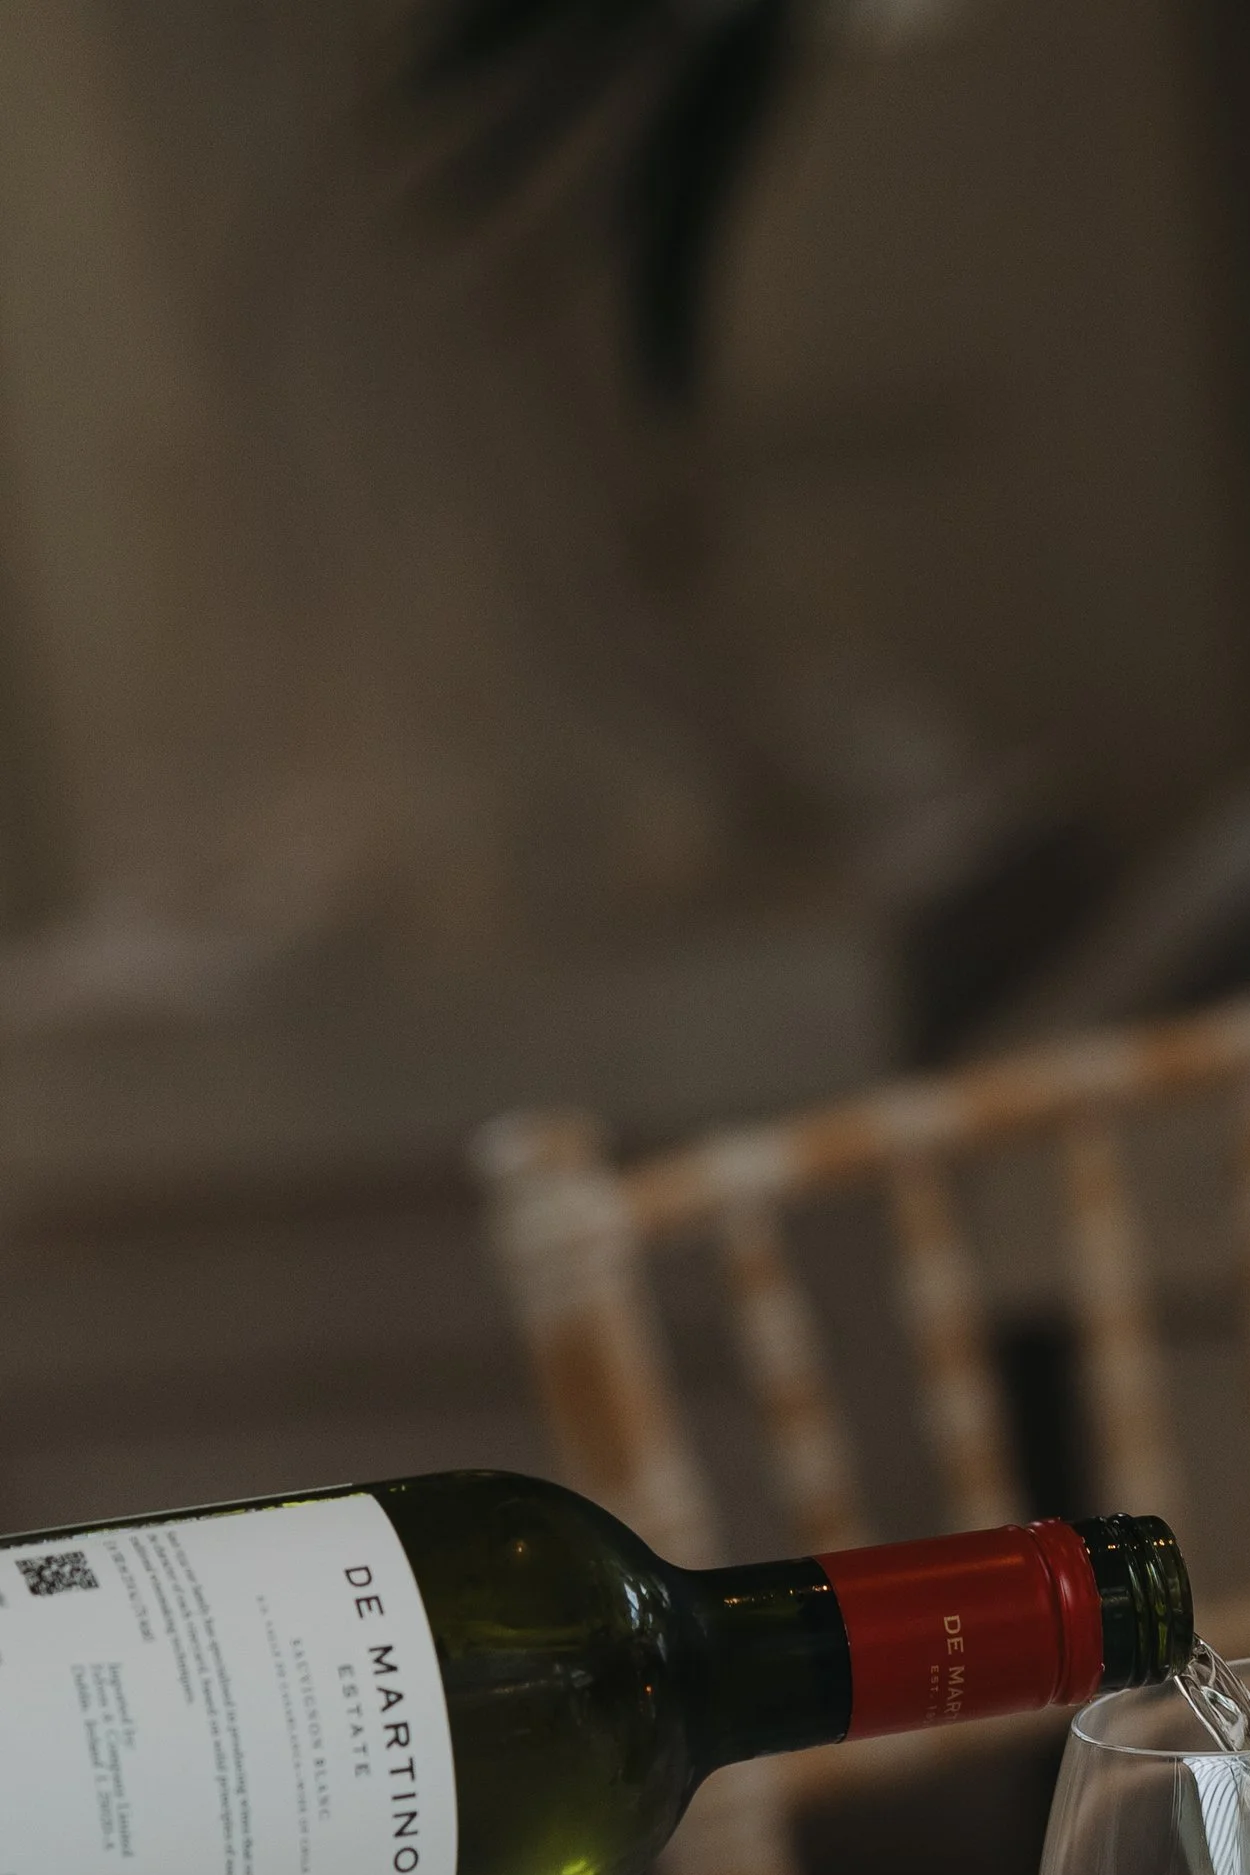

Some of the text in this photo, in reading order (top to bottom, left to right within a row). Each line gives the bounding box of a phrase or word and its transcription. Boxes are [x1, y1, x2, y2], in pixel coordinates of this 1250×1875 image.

[943, 1614, 964, 1655] DE
[337, 1664, 371, 1777] ESTATE
[344, 1565, 419, 1874] DE MARTINO
